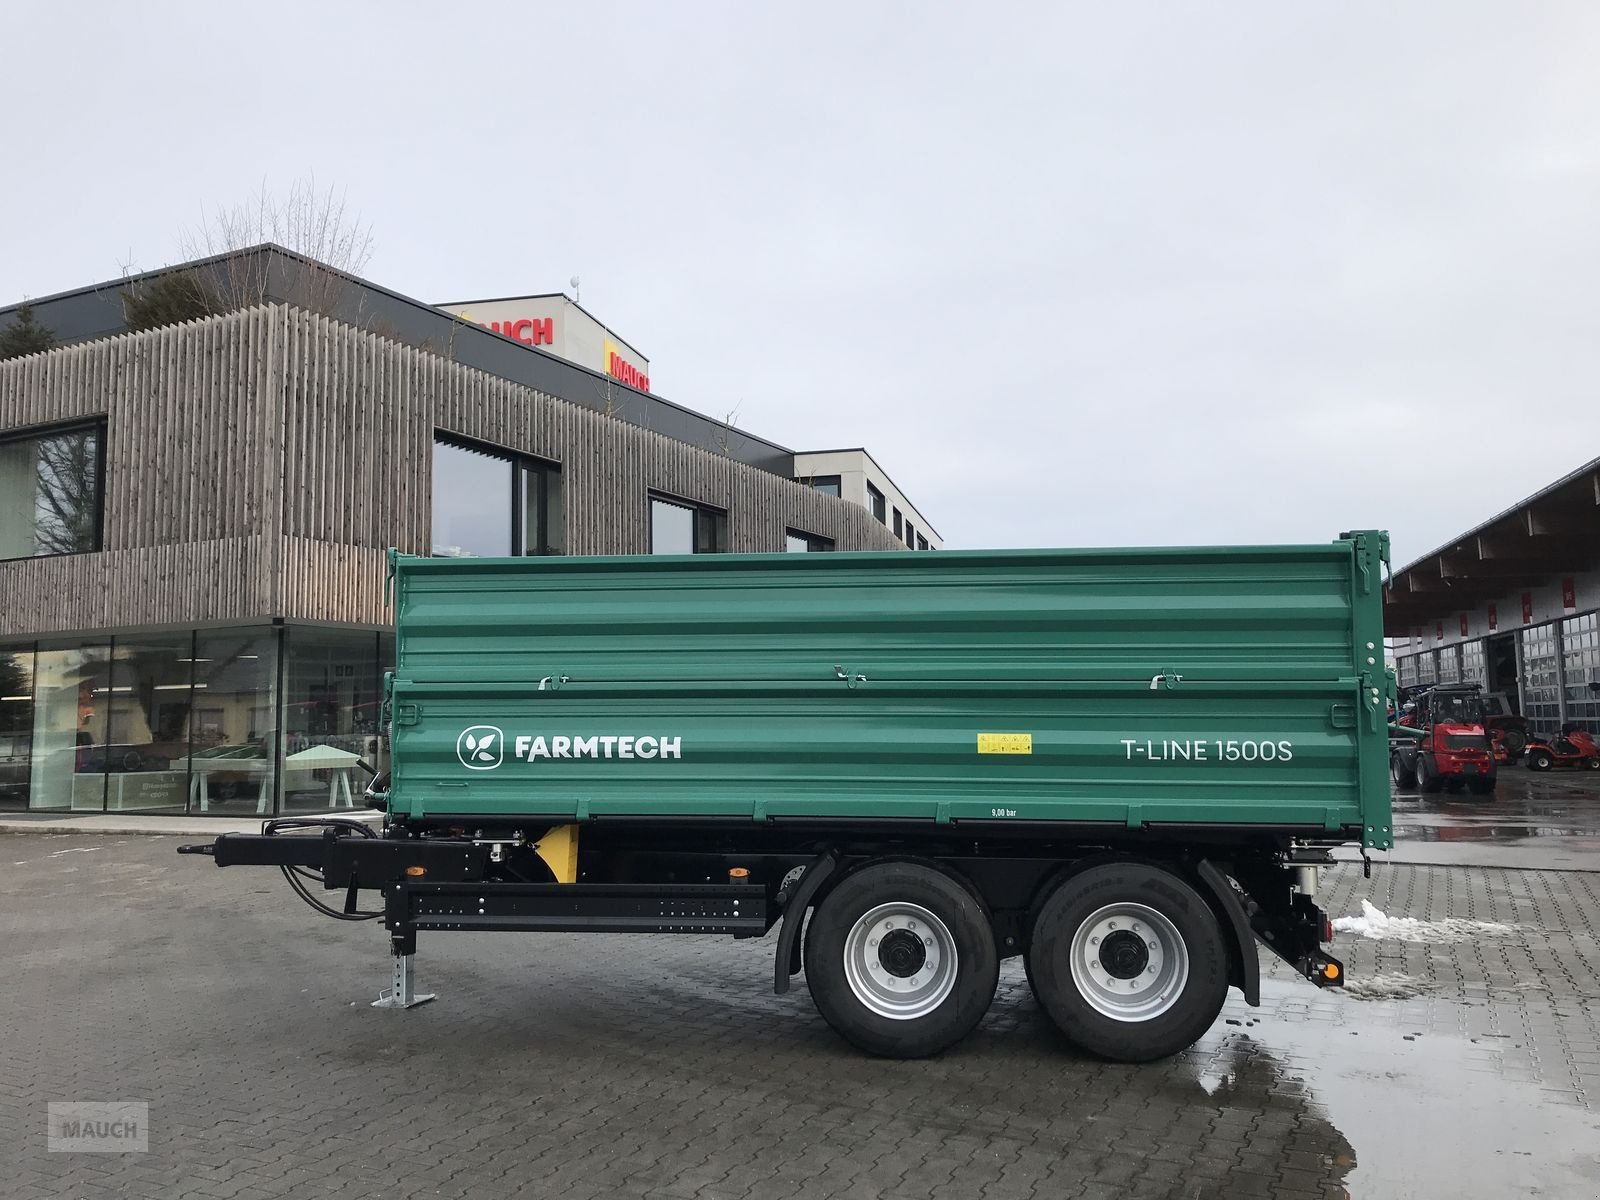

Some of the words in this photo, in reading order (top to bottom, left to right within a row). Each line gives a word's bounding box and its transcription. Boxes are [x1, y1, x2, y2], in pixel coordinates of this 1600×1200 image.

[610, 351, 650, 393] MAUCH
[515, 735, 682, 763] FARMTECH
[1120, 739, 1208, 761] T-LINE
[1215, 740, 1293, 762] 1500S
[991, 808, 1005, 817] 9,00
[1006, 808, 1017, 817] bar
